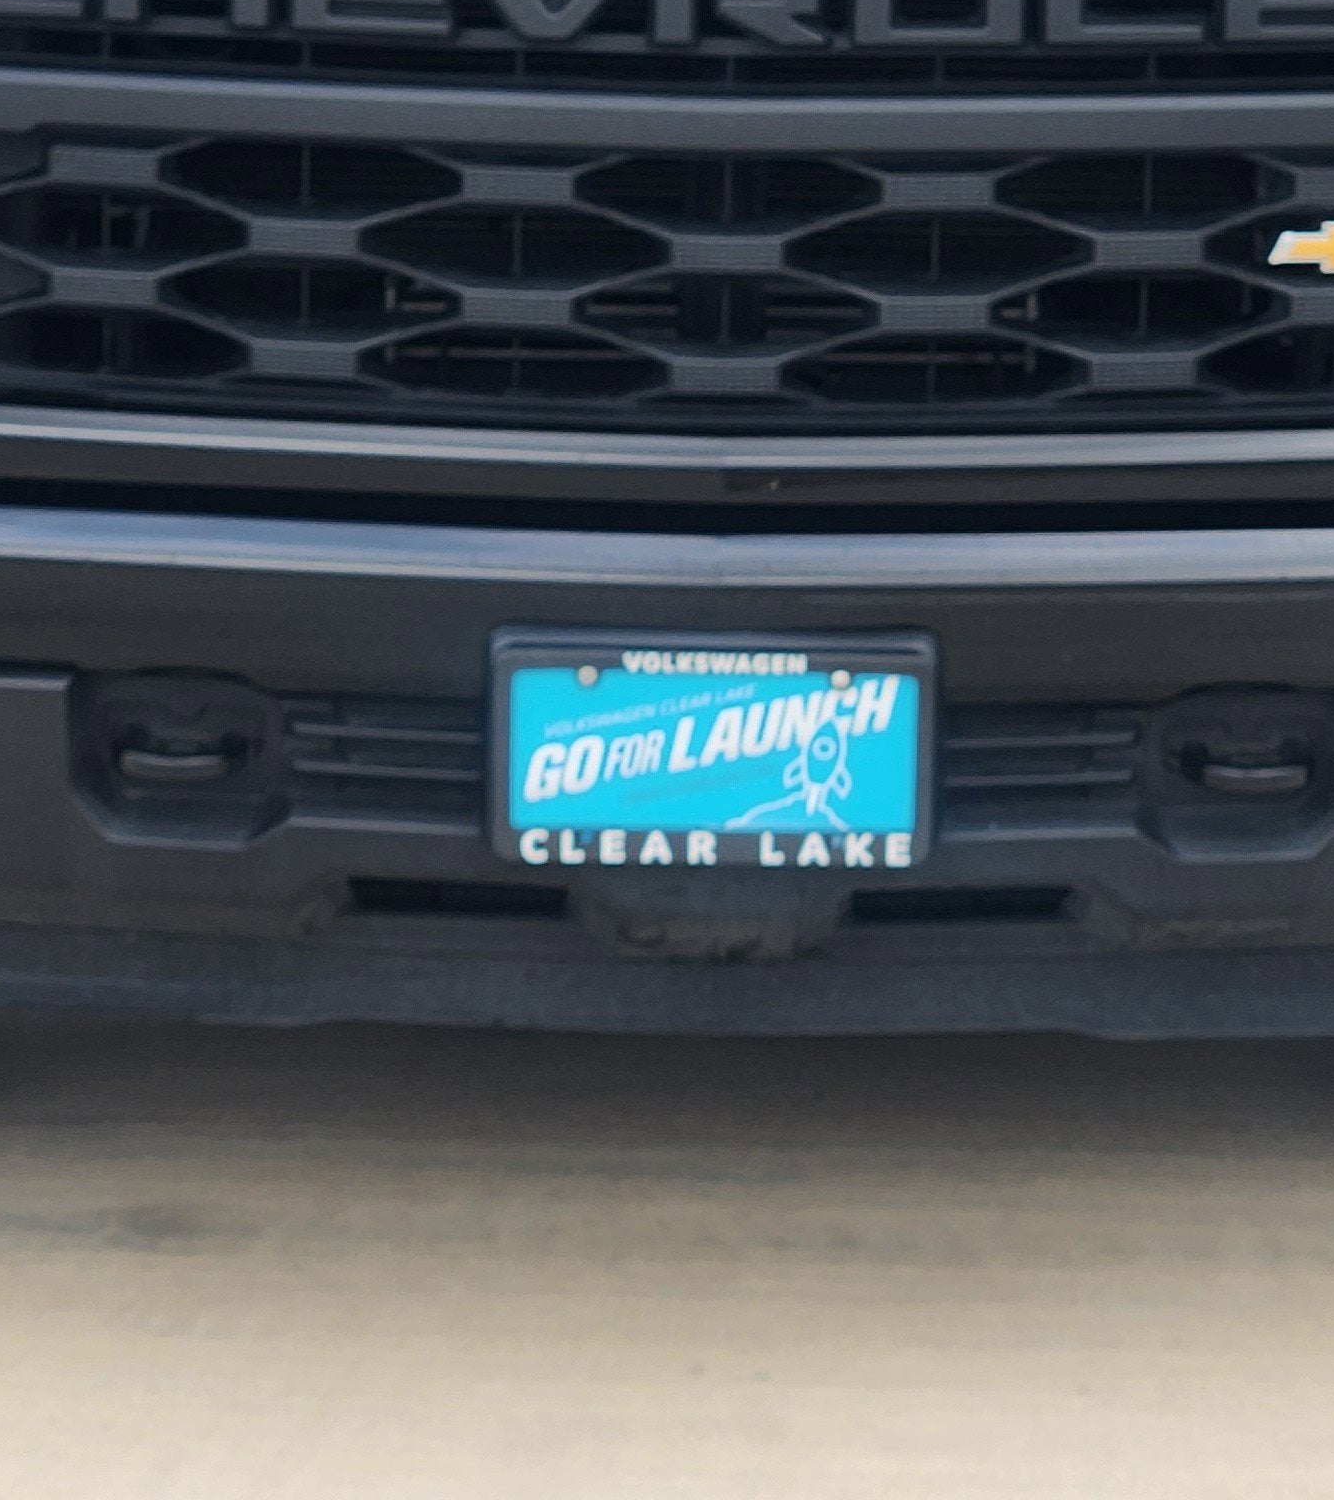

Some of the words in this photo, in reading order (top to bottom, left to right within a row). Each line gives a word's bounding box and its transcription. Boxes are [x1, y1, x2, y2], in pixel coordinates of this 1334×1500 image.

[622, 651, 808, 675] VOLKSWAGEN
[522, 734, 606, 804] GO
[602, 728, 667, 782] FOR
[667, 674, 902, 774] LAUNCH
[519, 829, 718, 866] CLEAR
[758, 831, 913, 868] LAKE
